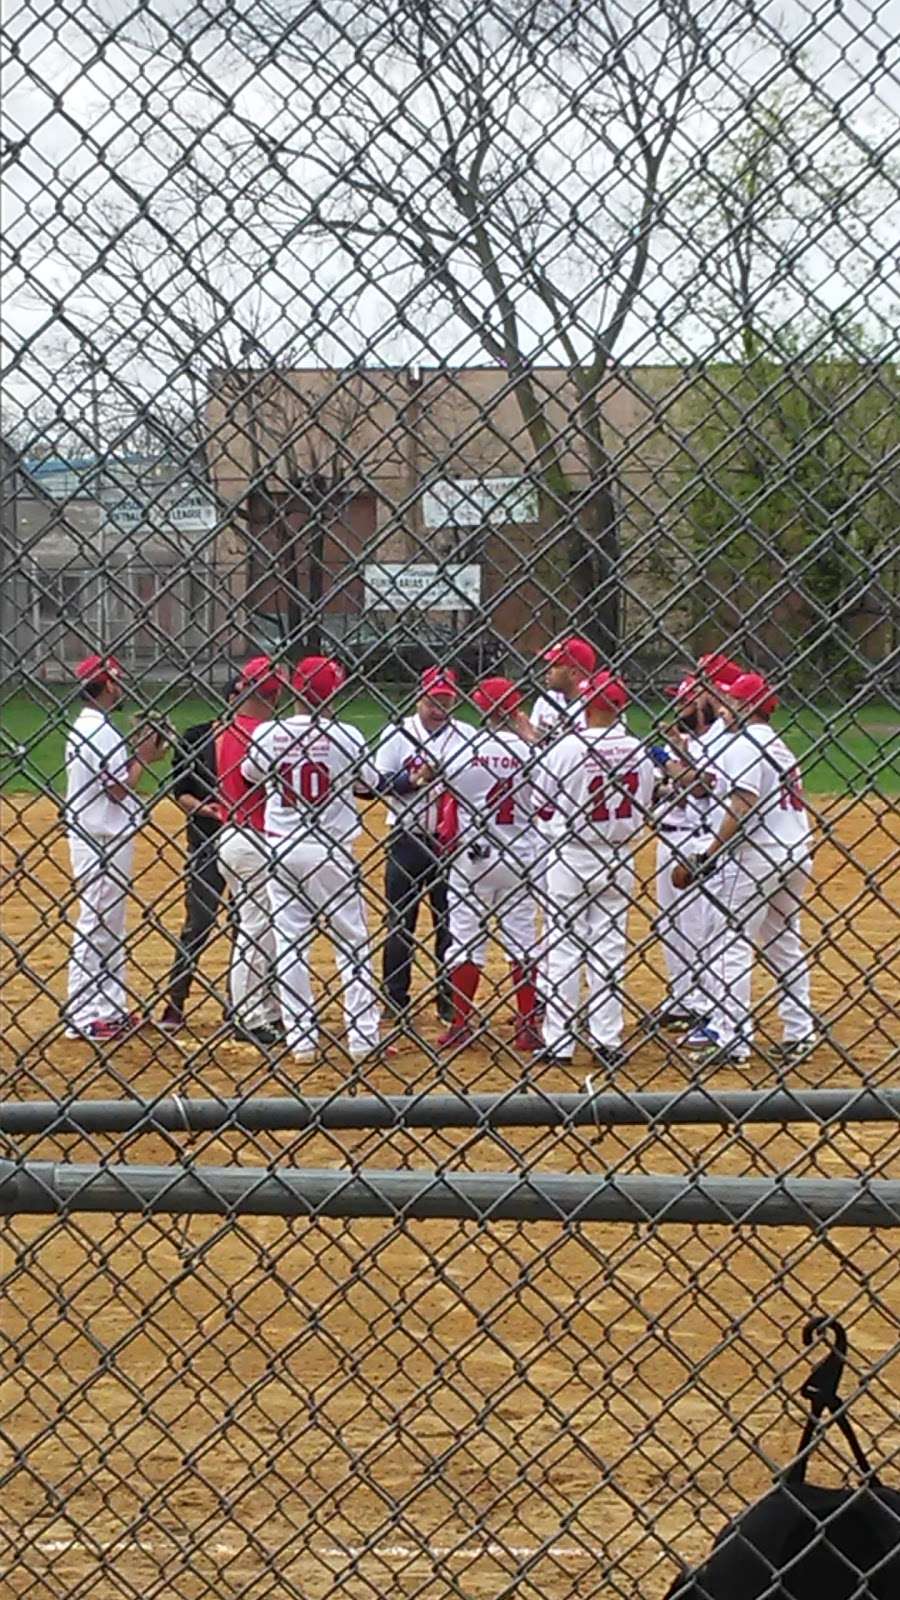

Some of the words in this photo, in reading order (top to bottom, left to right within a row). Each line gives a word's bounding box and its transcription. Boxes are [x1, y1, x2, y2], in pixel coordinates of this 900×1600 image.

[279, 761, 331, 808] 10
[485, 778, 515, 825] 4
[588, 771, 639, 822] 17
